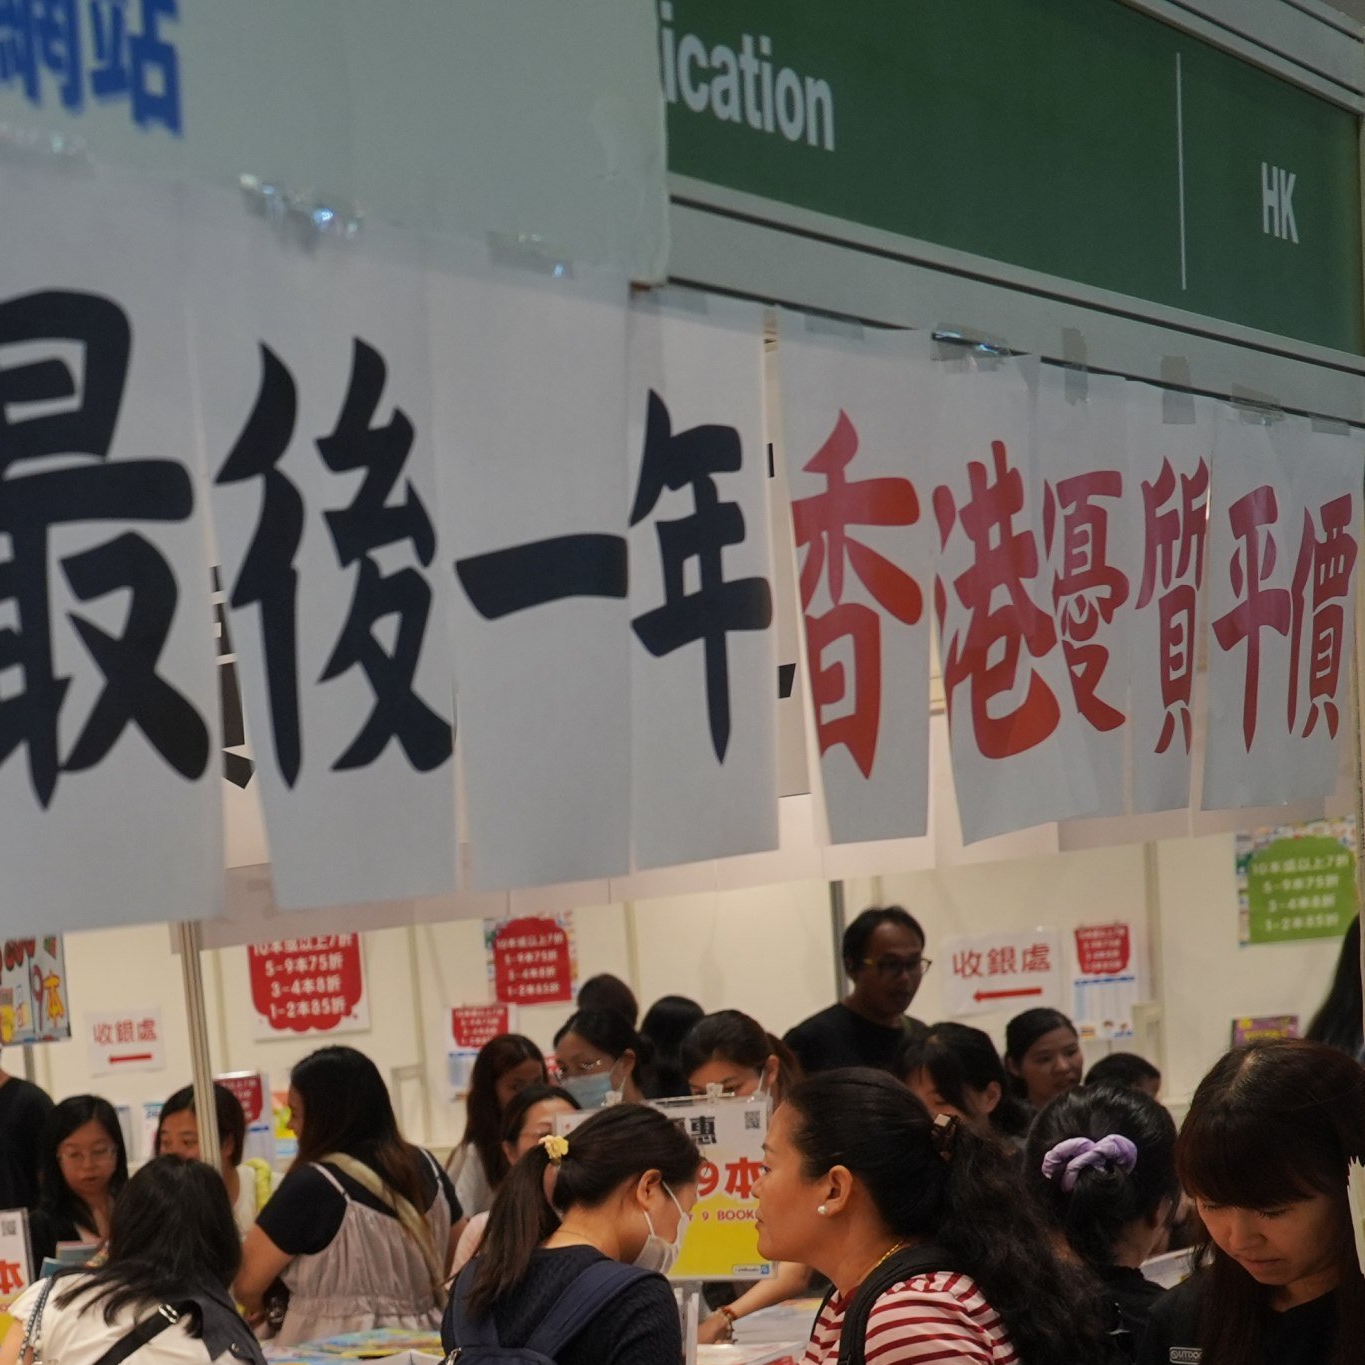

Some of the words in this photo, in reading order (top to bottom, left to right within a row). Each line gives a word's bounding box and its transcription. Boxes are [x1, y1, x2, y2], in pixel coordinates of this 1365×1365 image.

[1261, 162, 1300, 244] HK
[952, 943, 1052, 980] 收銀處
[92, 1017, 159, 1046] 收銀處
[718, 1209, 760, 1221] BOOK
